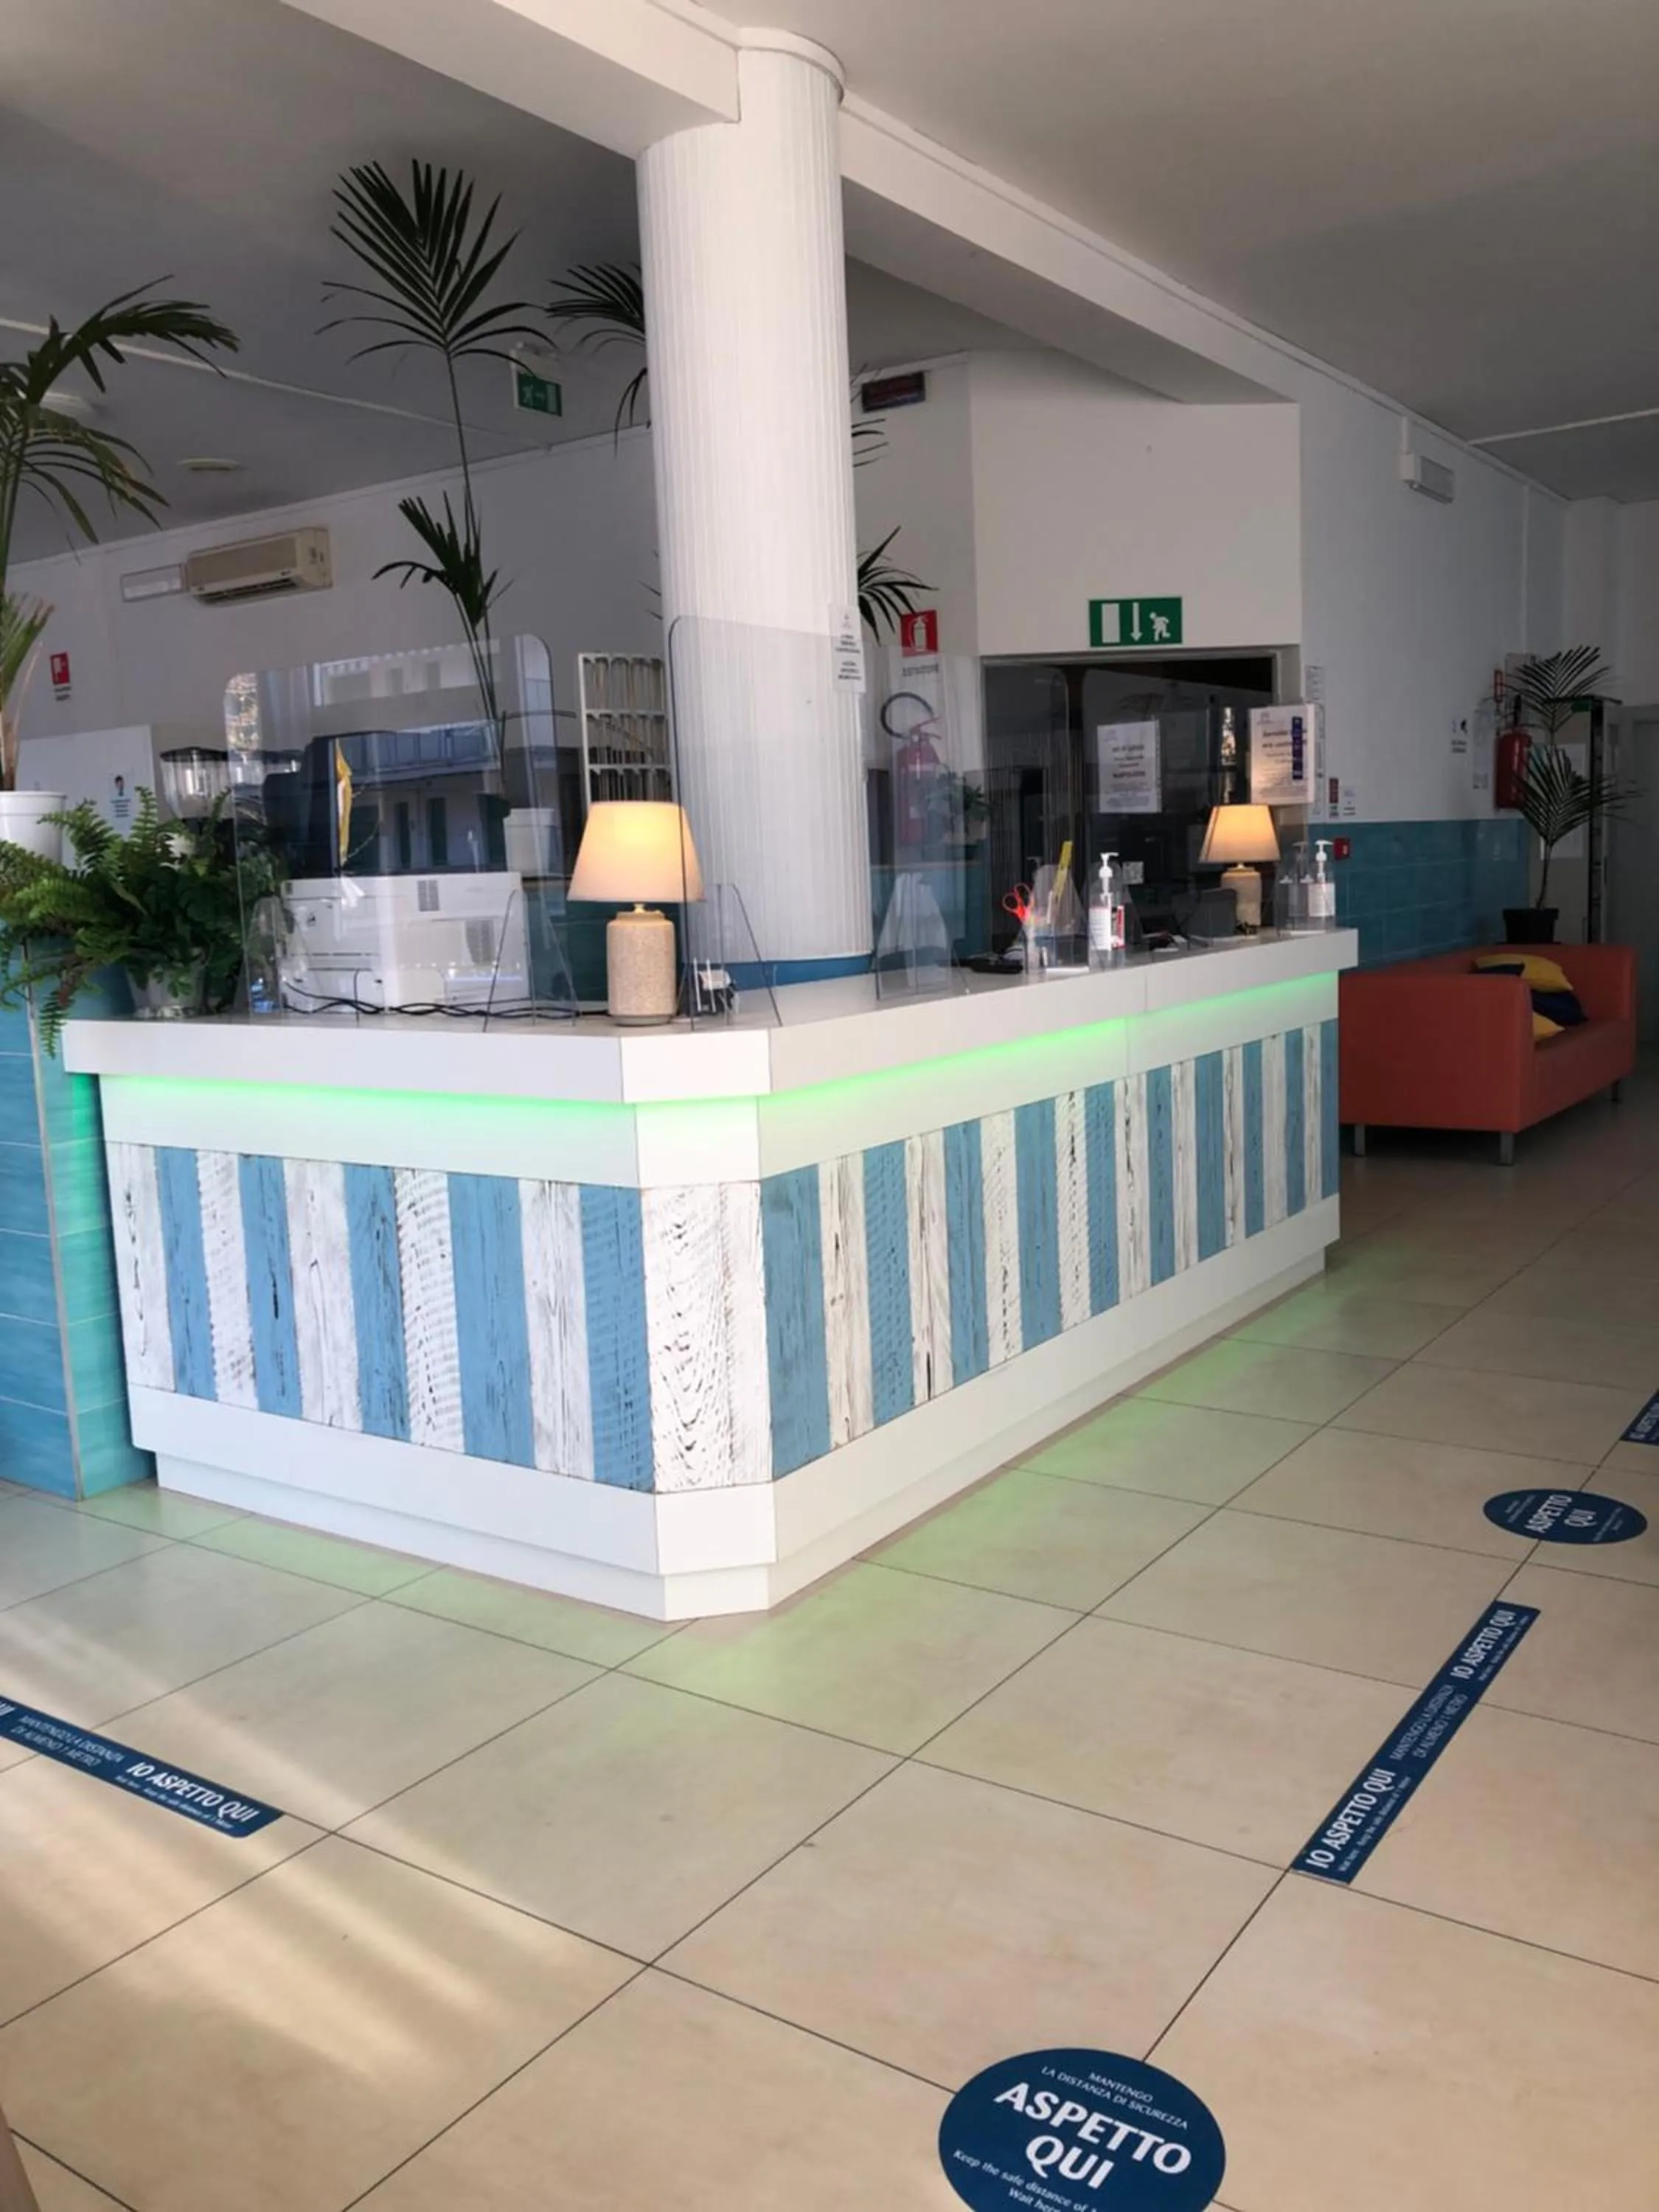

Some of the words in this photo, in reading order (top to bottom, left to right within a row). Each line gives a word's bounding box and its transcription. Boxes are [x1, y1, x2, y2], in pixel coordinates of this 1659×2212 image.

[1525, 1494, 1572, 1534] ASPETTO
[1489, 1610, 1516, 1627] QUI
[1461, 1627, 1503, 1666] ASPETTO
[1450, 1666, 1474, 1680] IO
[125, 1761, 156, 1778] IO
[145, 1772, 224, 1807] ASPETTO
[218, 1801, 260, 1823] QUI
[1305, 1849, 1335, 1868] IO
[1321, 1792, 1377, 1851] ASPETTO
[1363, 1767, 1397, 1792] QUI
[1040, 2066, 1055, 2078] LA
[1057, 2071, 1111, 2100] DISTANZA
[1113, 2095, 1127, 2107] DI
[1128, 2100, 1189, 2130] SICUREZZA
[1089, 2071, 1154, 2103] MANTENGO
[993, 2081, 1192, 2174] ASPETTO
[953, 2149, 980, 2168] Keep
[981, 2161, 1000, 2175] the
[1001, 2171, 1024, 2187] safe
[1026, 2181, 1071, 2207] distance
[1026, 2135, 1115, 2189] QUI
[1008, 2187, 1034, 2205] Wait
